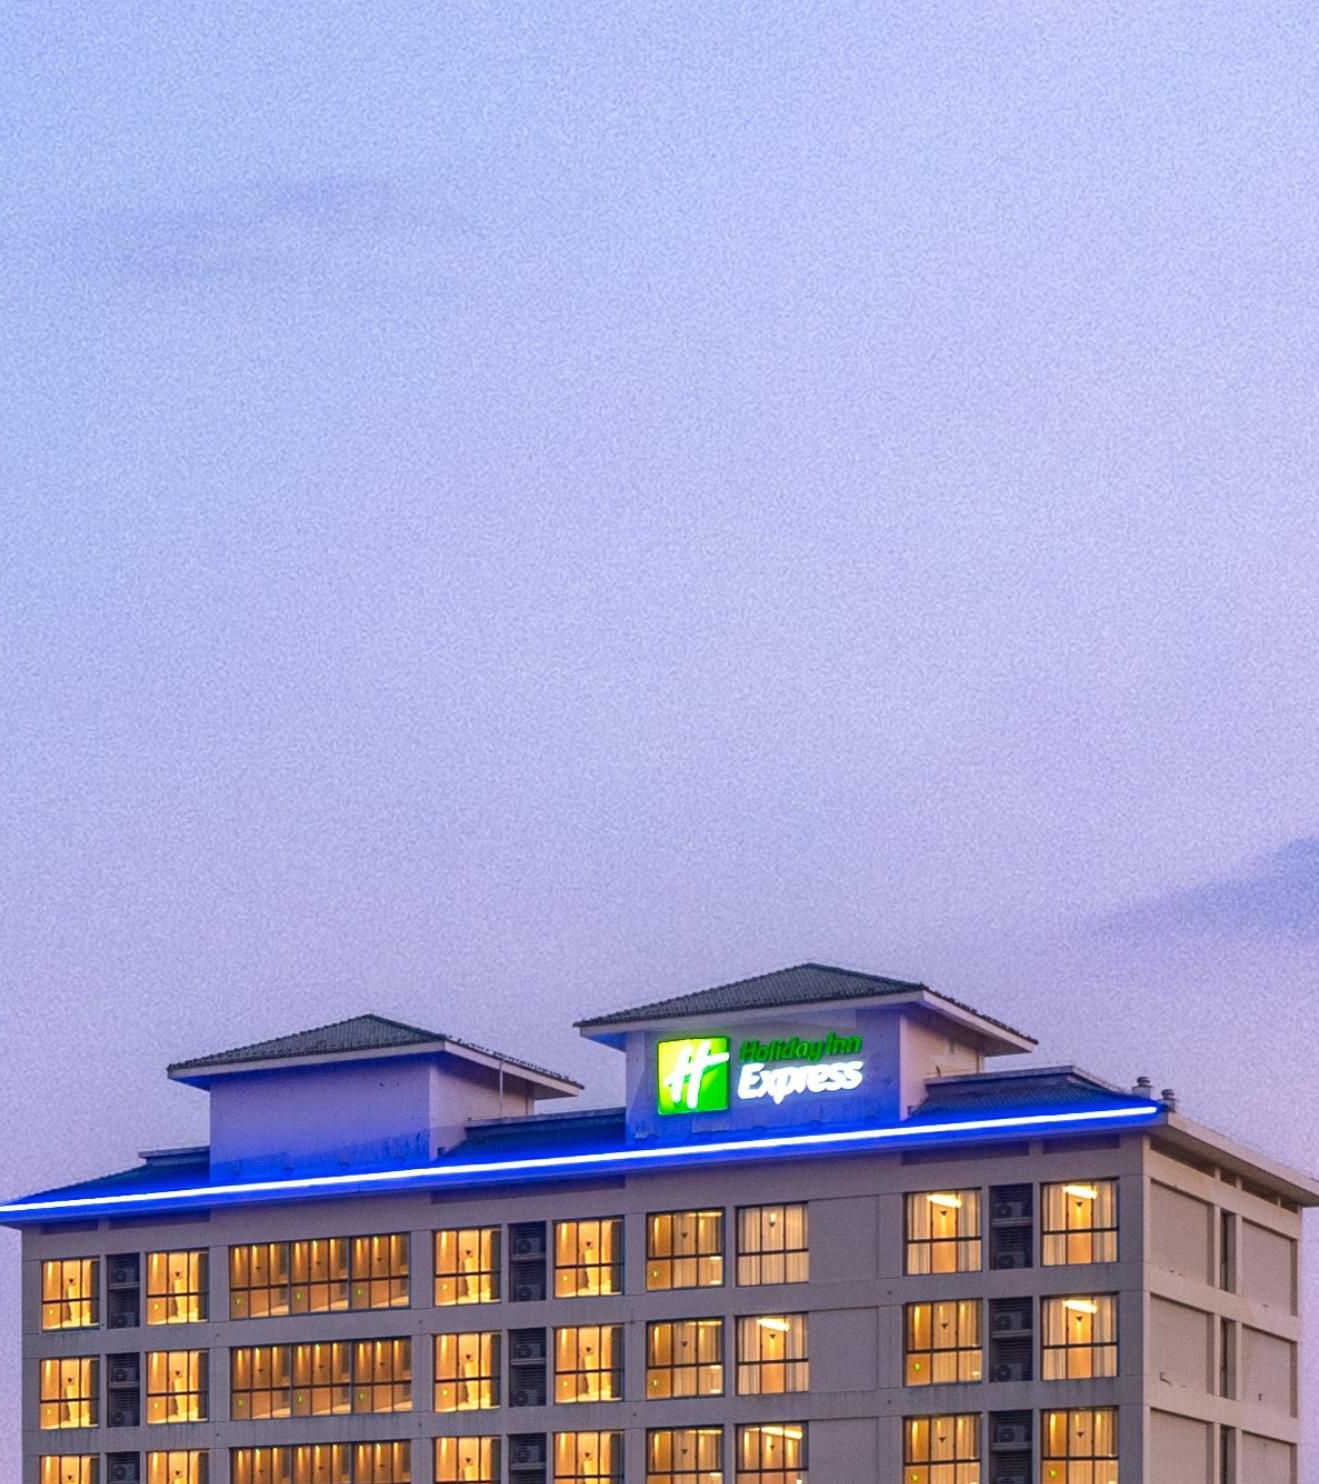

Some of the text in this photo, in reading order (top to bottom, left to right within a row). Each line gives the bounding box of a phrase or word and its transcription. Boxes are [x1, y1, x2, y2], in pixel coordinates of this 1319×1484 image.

[740, 1031, 862, 1063] Holiday Inn
[737, 1060, 864, 1105] Express
